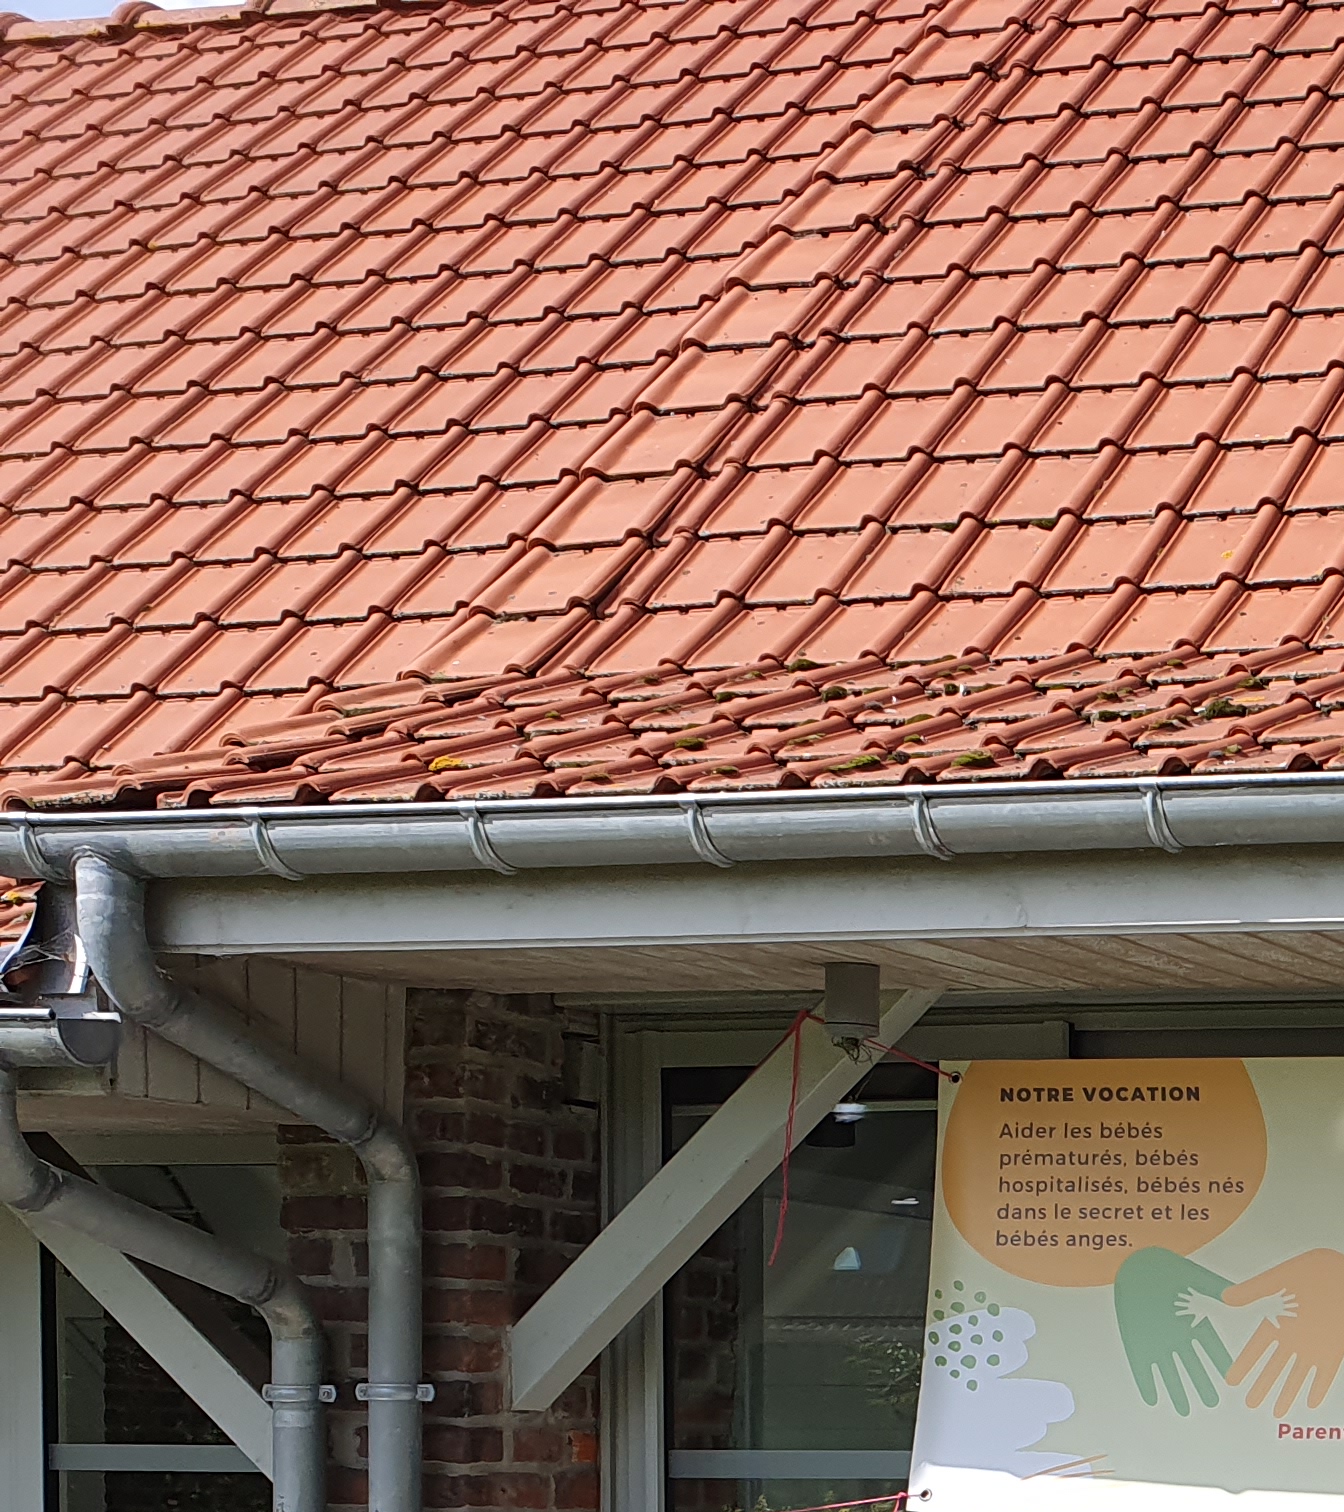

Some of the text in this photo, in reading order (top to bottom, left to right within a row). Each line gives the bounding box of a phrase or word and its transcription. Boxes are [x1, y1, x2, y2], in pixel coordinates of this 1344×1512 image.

[1000, 1086, 1200, 1102] NOTRE VOCATION
[999, 1121, 1163, 1139] Aider les bébés
[999, 1149, 1199, 1169] prématurés, bébés
[998, 1176, 1245, 1196] hospitalisés, bébés nés
[996, 1203, 1210, 1221] dans le secret et les
[996, 1230, 1133, 1250] bébés anges.
